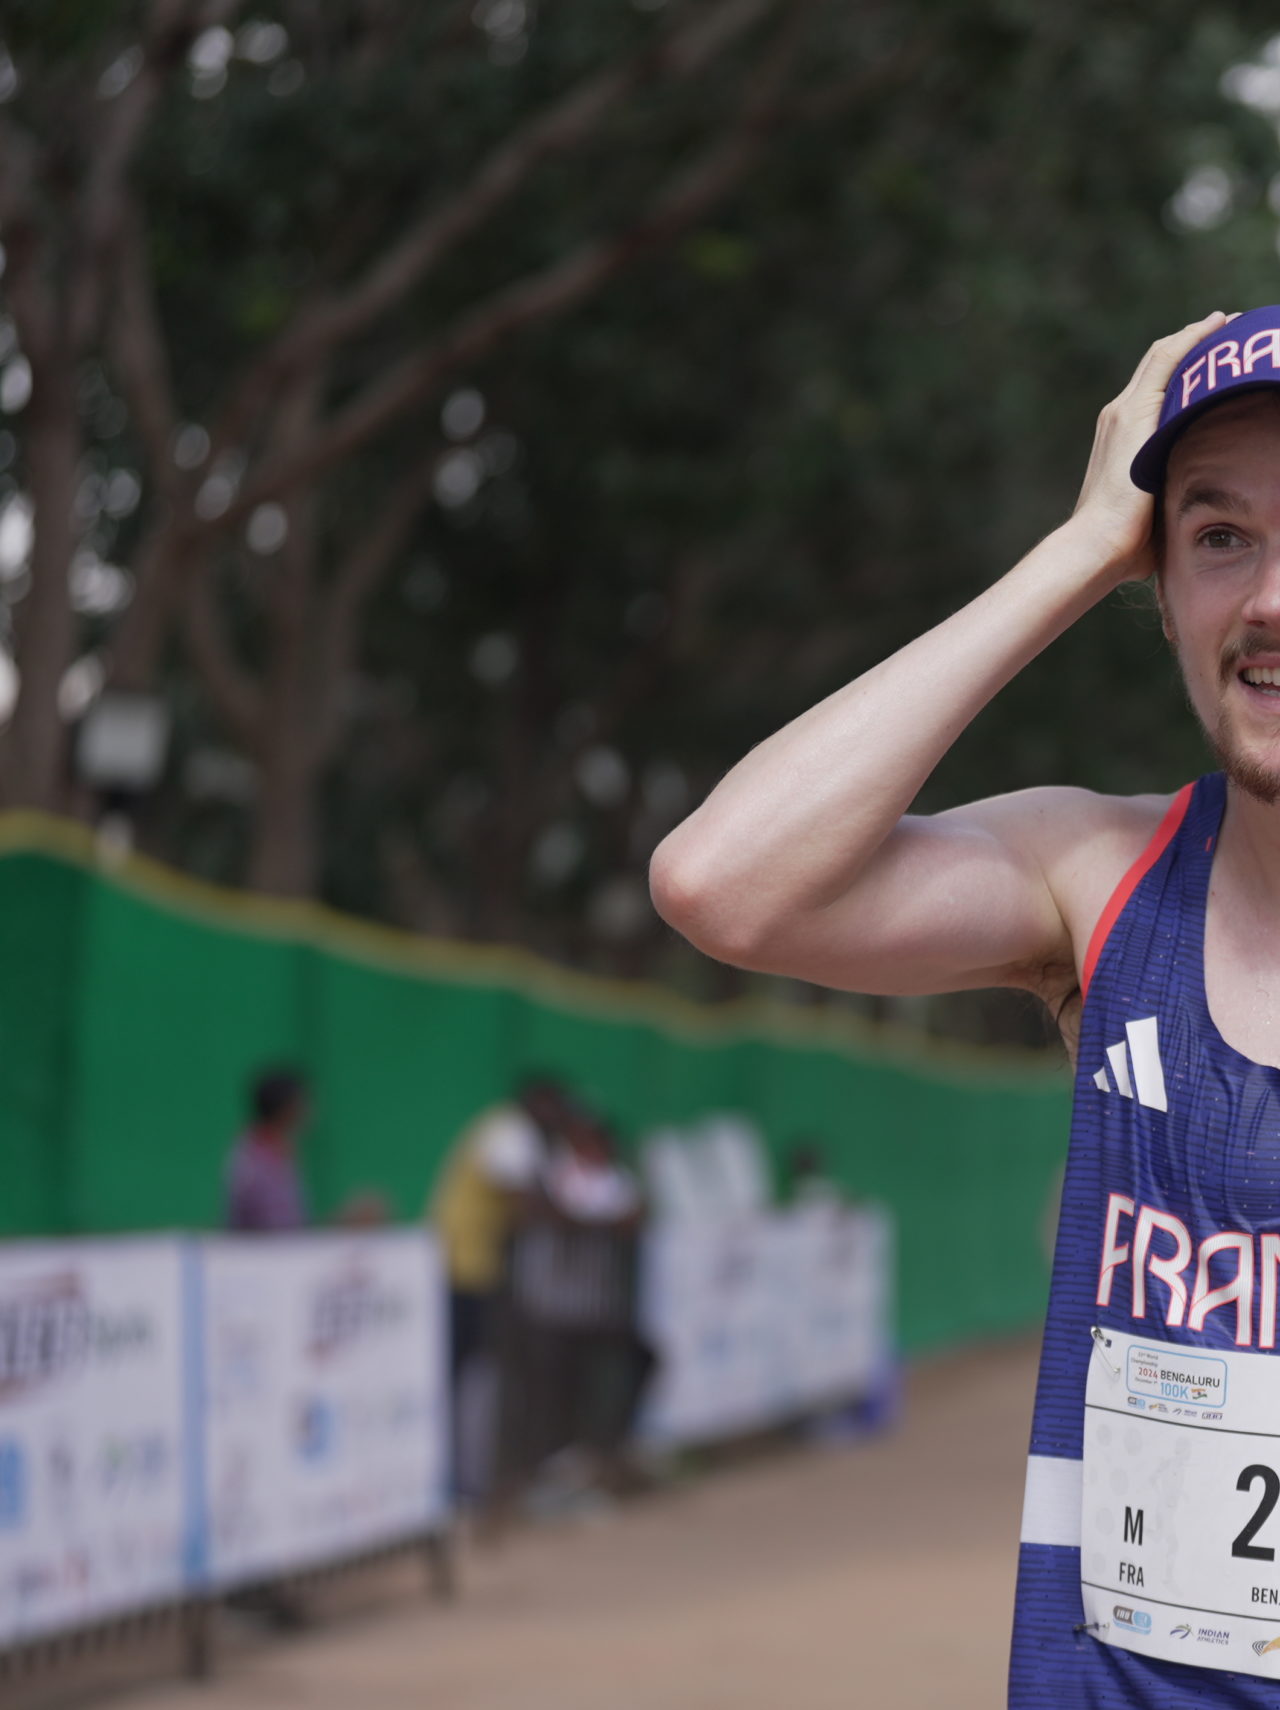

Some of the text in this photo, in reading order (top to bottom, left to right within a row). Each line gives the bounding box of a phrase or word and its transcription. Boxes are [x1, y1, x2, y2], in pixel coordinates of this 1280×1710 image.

[1138, 1367, 1220, 1388] 2024 BENGALURU
[1160, 1382, 1189, 1399] 100K
[1123, 1506, 1144, 1546] M
[1119, 1562, 1144, 1587] FRA
[1198, 1628, 1230, 1639] INDIAN
